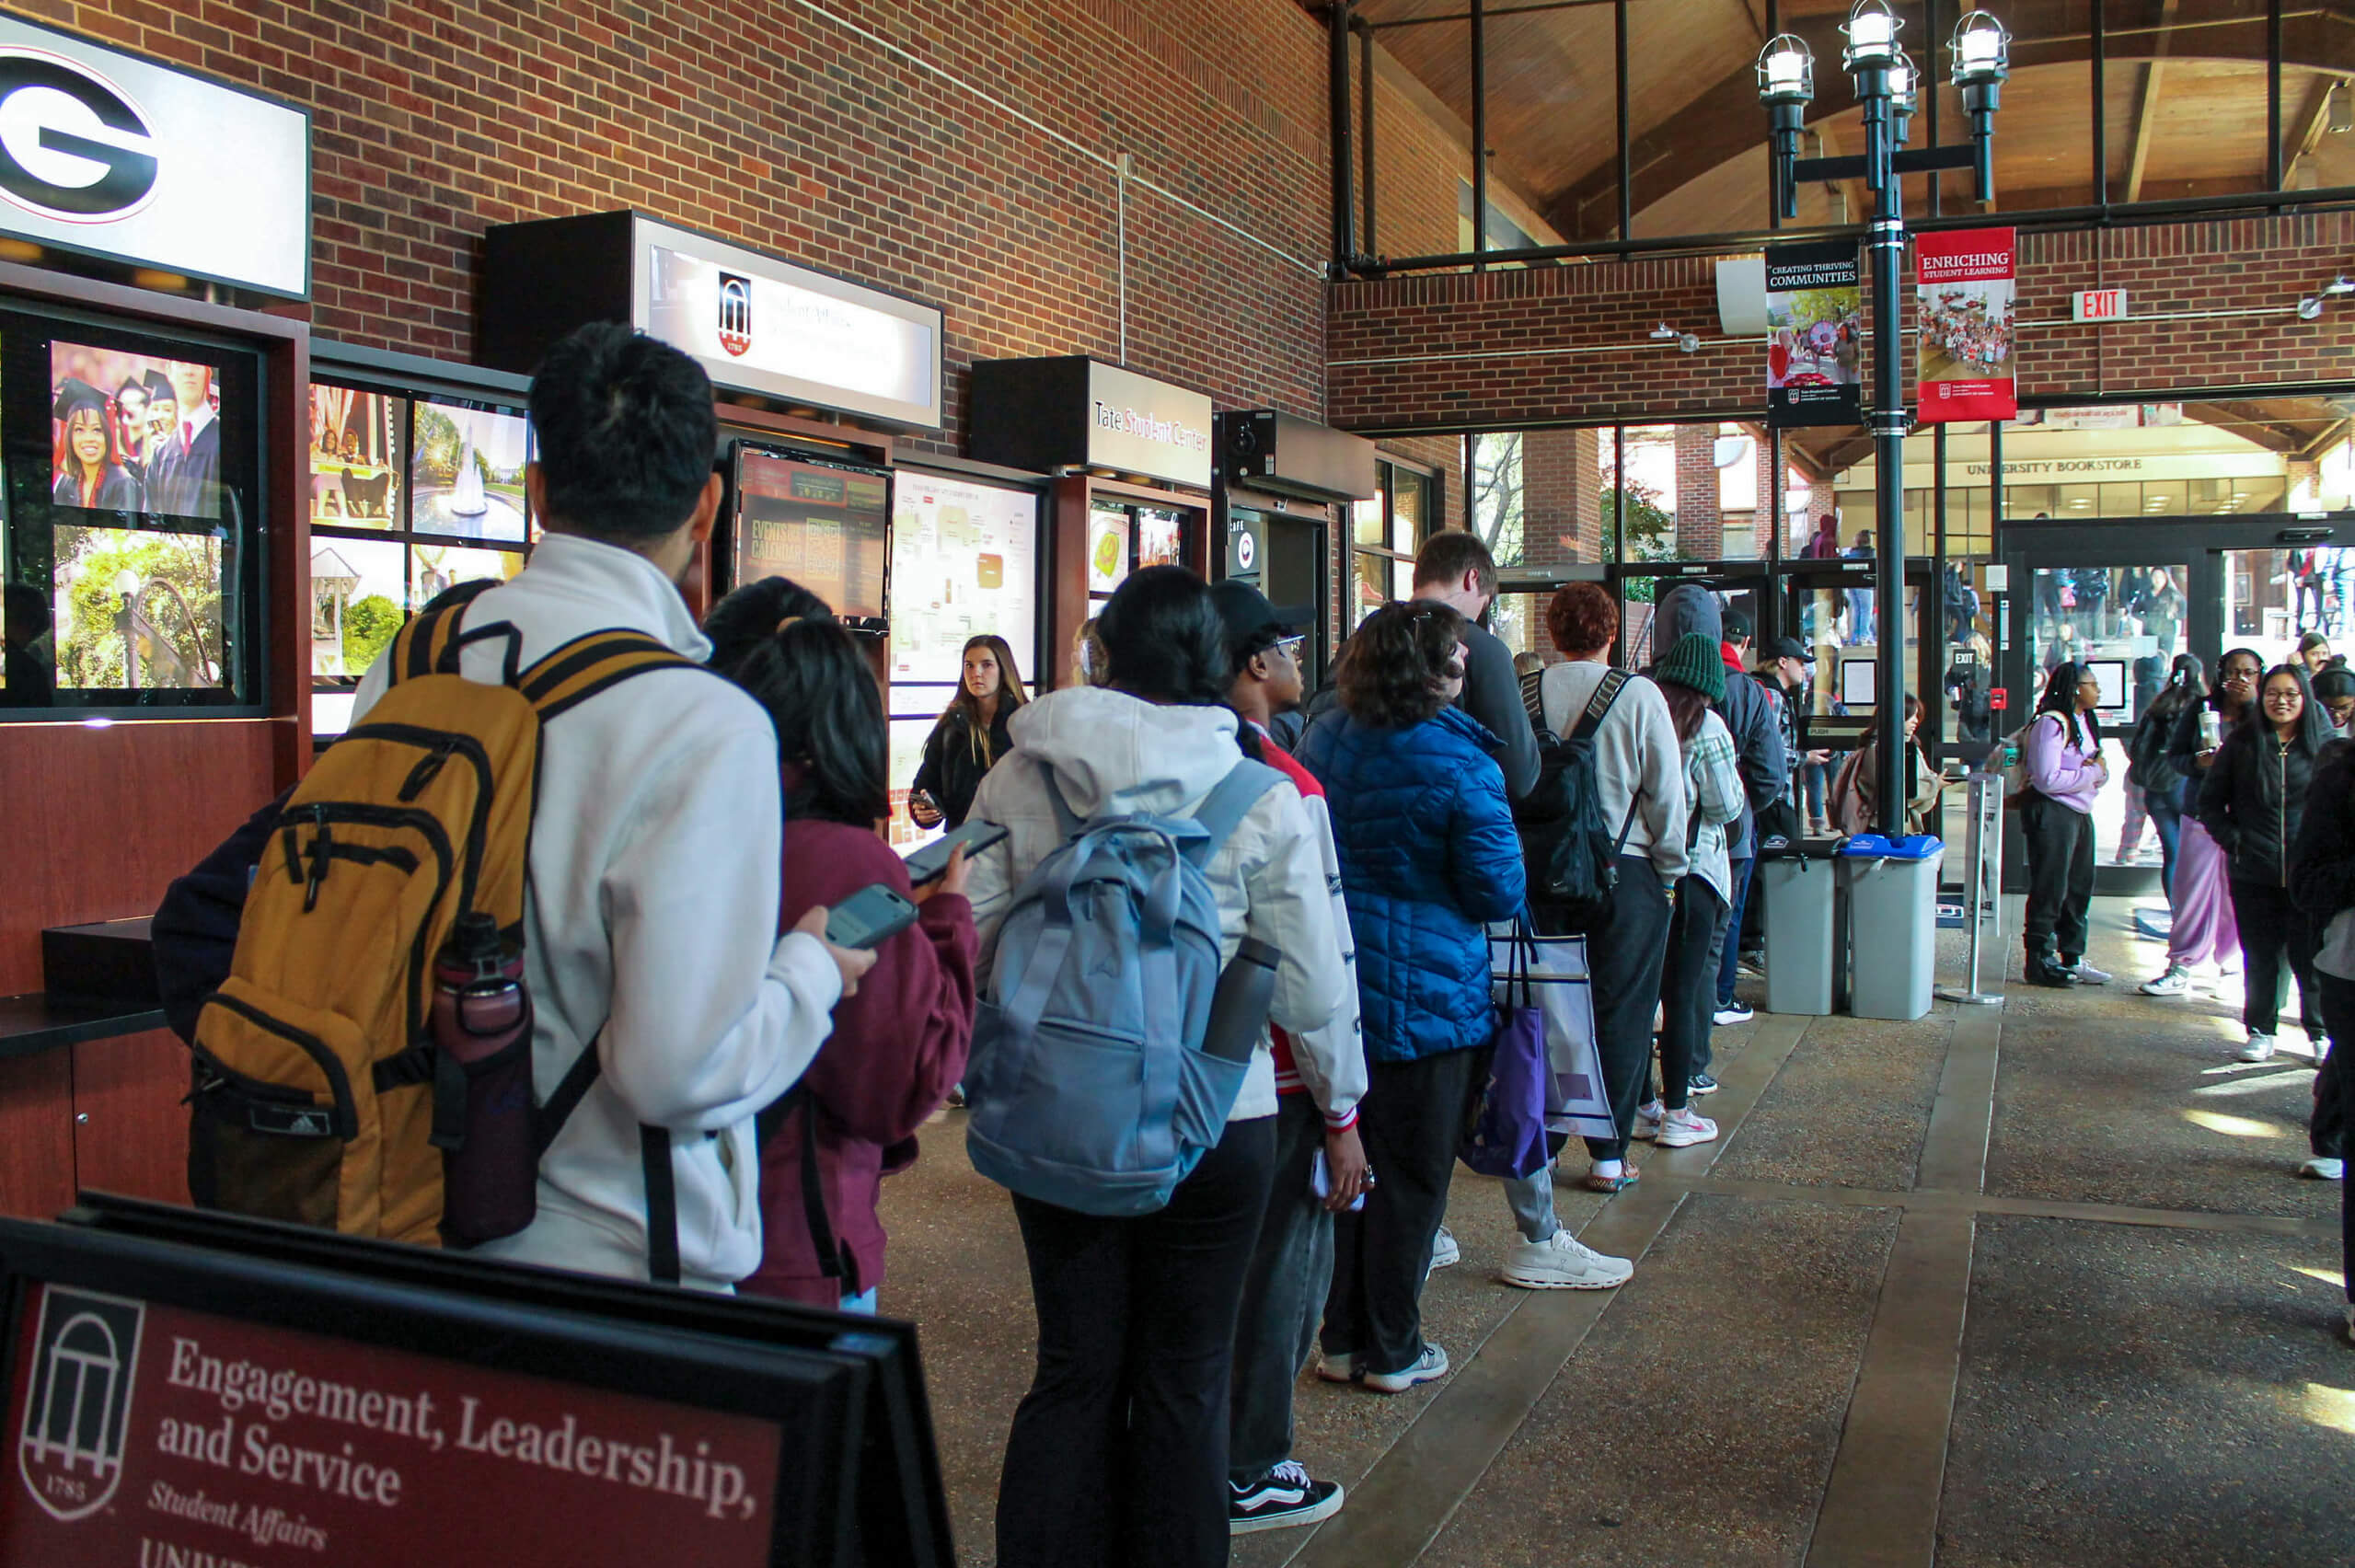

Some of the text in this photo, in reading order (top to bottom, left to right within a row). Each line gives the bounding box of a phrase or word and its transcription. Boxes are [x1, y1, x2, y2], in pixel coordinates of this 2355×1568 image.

[1772, 261, 1854, 274] CREATING THRIVING
[1922, 252, 2009, 270] ENRICHING
[1770, 271, 1856, 287] COMMUNITIES
[1923, 266, 2008, 279] STUDENT LEARNING
[2084, 291, 2118, 318] EXIT
[1095, 401, 1207, 451] Tate Student Center
[1968, 459, 2142, 476] UNIERSITY BOOKSTORE
[1956, 653, 1974, 663] EXIT
[167, 1336, 756, 1519] Engagement, Leadership,
[157, 1415, 402, 1506] and Service
[147, 1481, 329, 1551] Student Affairs
